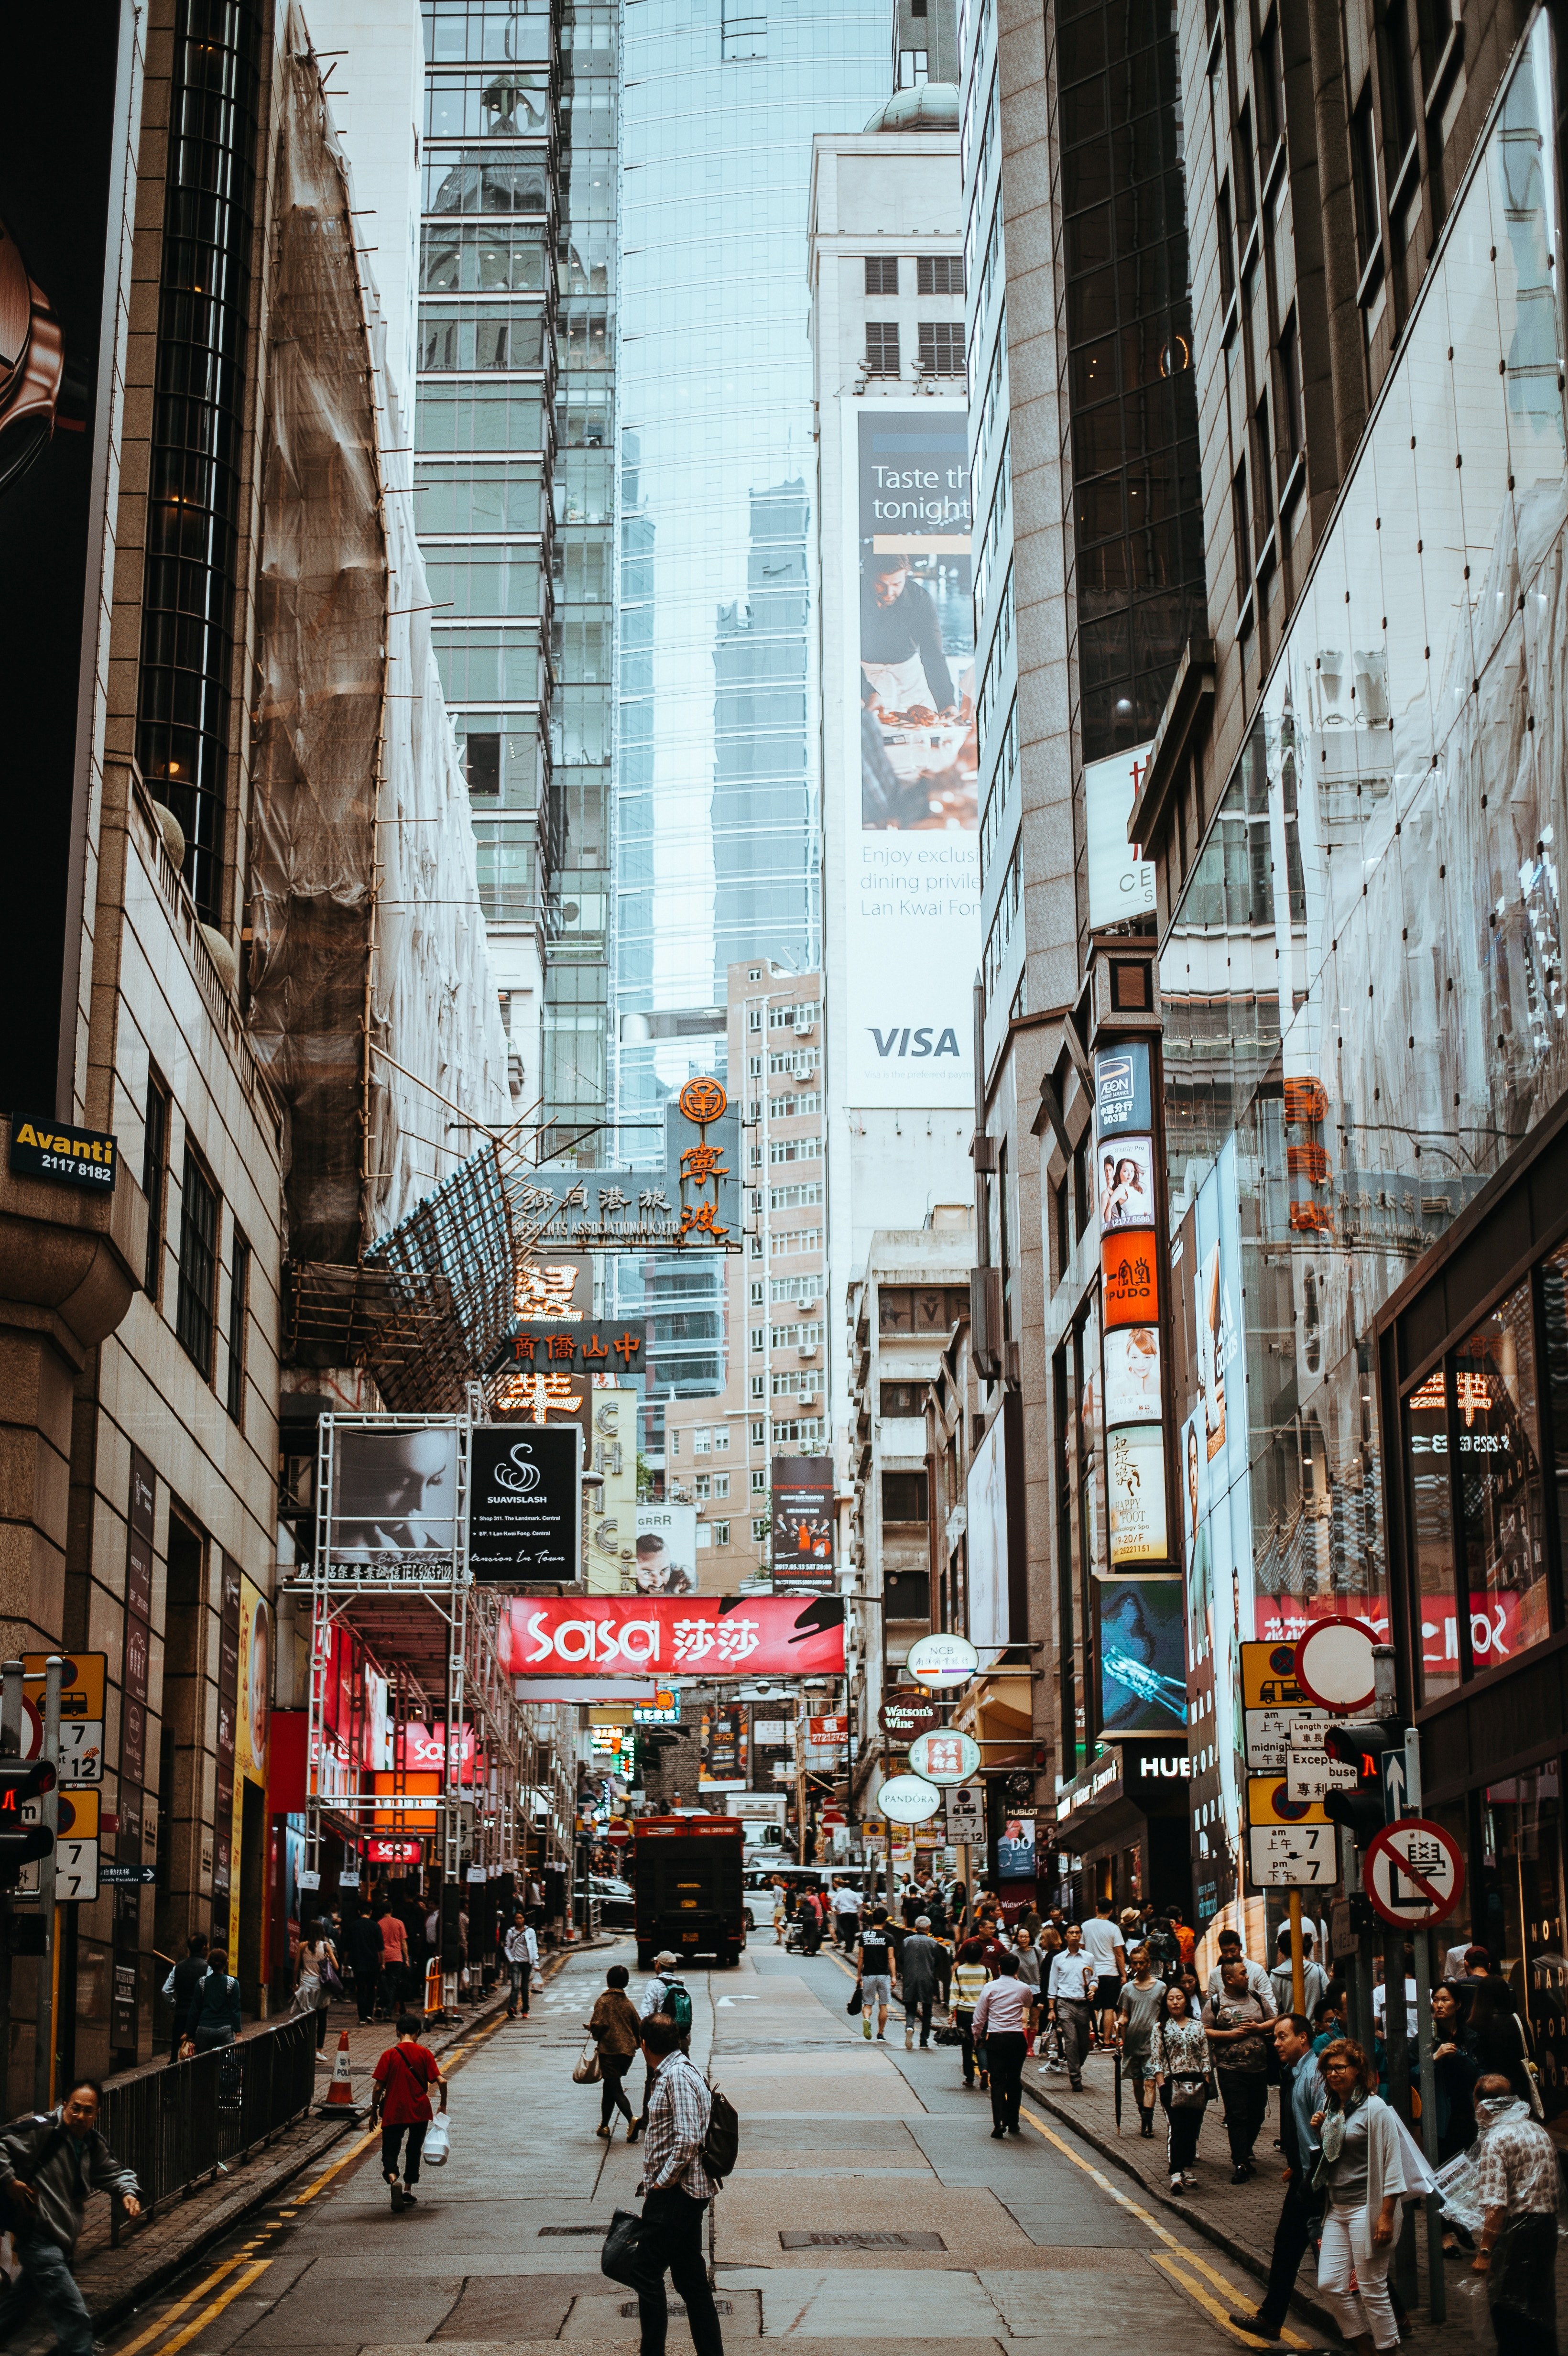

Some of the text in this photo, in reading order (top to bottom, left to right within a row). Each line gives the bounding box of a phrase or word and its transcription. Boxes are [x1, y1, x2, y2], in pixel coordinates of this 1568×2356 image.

[871, 466, 939, 488] Taste
[872, 495, 971, 525] tonight
[863, 847, 912, 867] Enjoy
[860, 873, 919, 893] dining
[862, 900, 893, 915] Lan
[901, 900, 942, 915] Kwai
[864, 1027, 960, 1057] VISA
[864, 1070, 881, 1079] Visa
[892, 1070, 905, 1079] the
[907, 1070, 946, 1080] preferred
[16, 1123, 113, 1164] Avanti
[42, 1155, 111, 1181] 2117 8182
[1115, 1498, 1141, 1512] HAPPY
[638, 1515, 671, 1525] GRRR
[1121, 1510, 1146, 1524] FOOT
[535, 1549, 566, 1563] Town
[1120, 1544, 1150, 1555] 25221151
[525, 1611, 761, 1662] Sasa 莎莎
[930, 1647, 954, 1655] NCB
[884, 1704, 934, 1717] Watson's
[884, 1716, 914, 1728] Wine
[1261, 1721, 1285, 1732] 上午
[1294, 1723, 1321, 1731] Length
[72, 1725, 86, 1745] 7
[1302, 1733, 1323, 1743] 車長
[414, 1738, 469, 1761] Saa
[1252, 1742, 1292, 1752] midnigh
[1262, 1754, 1286, 1765] 午夜
[1293, 1754, 1333, 1766] Except
[71, 1757, 97, 1777] 12
[1329, 1767, 1357, 1777] buse
[1006, 1808, 1039, 1816] HUBLOT
[969, 1818, 977, 1827] 7
[971, 1832, 983, 1842] 12
[1010, 1836, 1032, 1851] DO
[1267, 1838, 1292, 1850] 上午
[1306, 1830, 1319, 1849] 7
[68, 1844, 82, 1865] 7
[1272, 1861, 1288, 1869] pm
[1307, 1861, 1321, 1881] 7
[1268, 1870, 1293, 1882] 下午
[68, 1876, 82, 1896] 7
[1531, 1917, 1560, 1942] NOT
[1536, 2016, 1567, 2039] FOR
